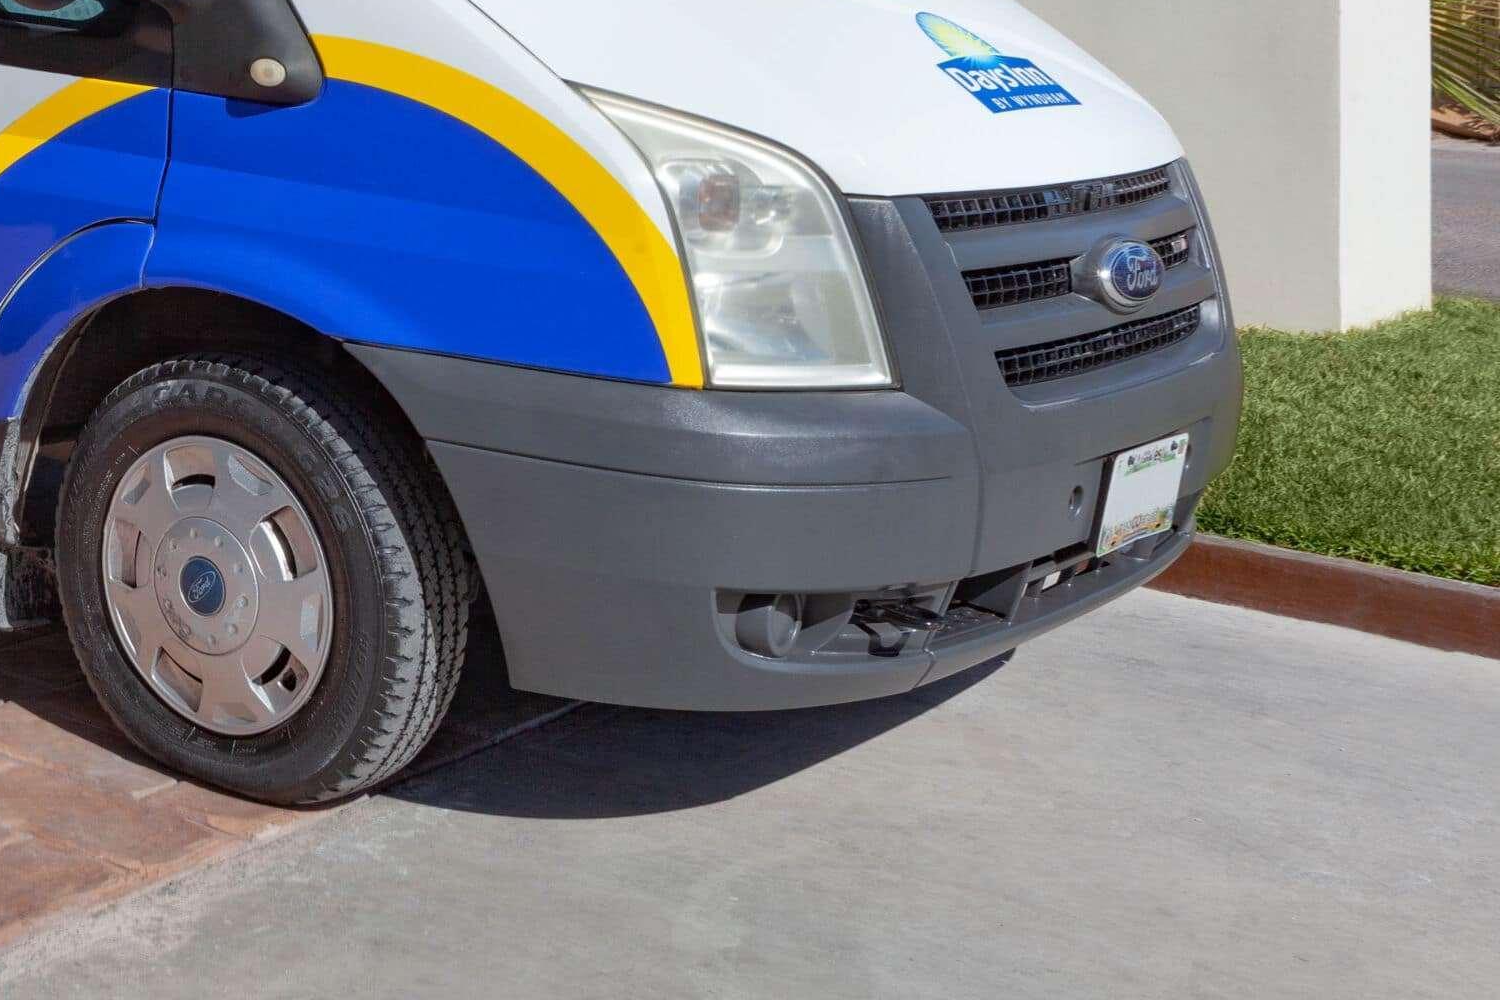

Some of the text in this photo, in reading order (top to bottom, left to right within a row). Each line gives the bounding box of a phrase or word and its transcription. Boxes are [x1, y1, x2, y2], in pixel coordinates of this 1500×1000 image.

[945, 63, 1057, 93] Days Inn
[991, 92, 1073, 110] BY WYNDHAM
[1126, 253, 1158, 291] Ford
